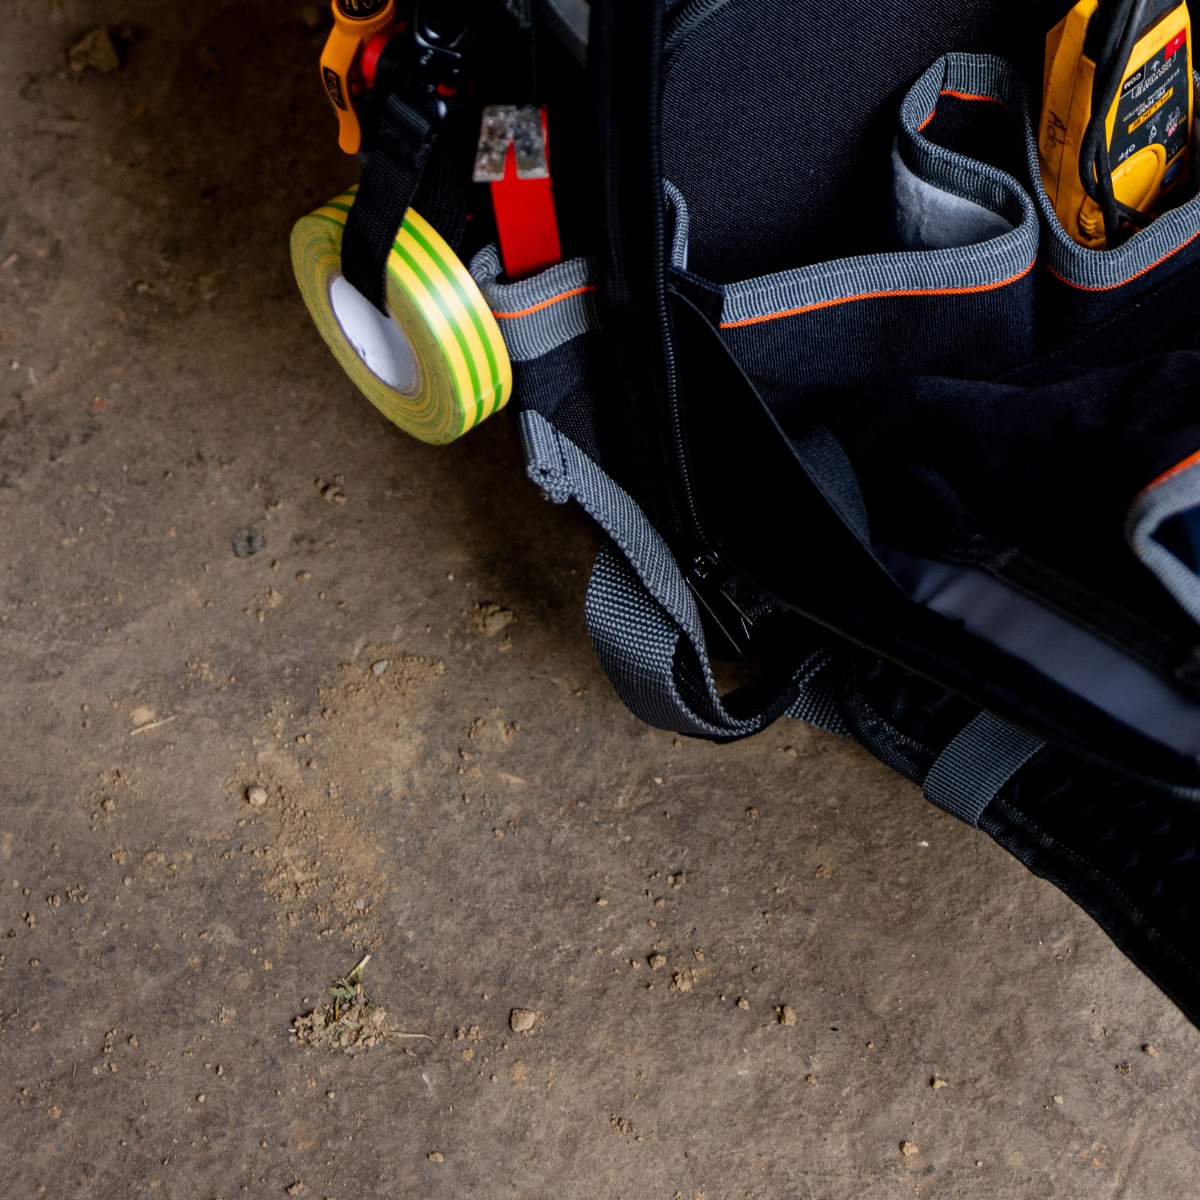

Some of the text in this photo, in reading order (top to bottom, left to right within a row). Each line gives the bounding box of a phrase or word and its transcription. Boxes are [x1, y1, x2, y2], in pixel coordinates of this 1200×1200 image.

[1124, 73, 1142, 90] COM
[1134, 92, 1169, 129] FLUKE
[1119, 144, 1136, 160] OFF
